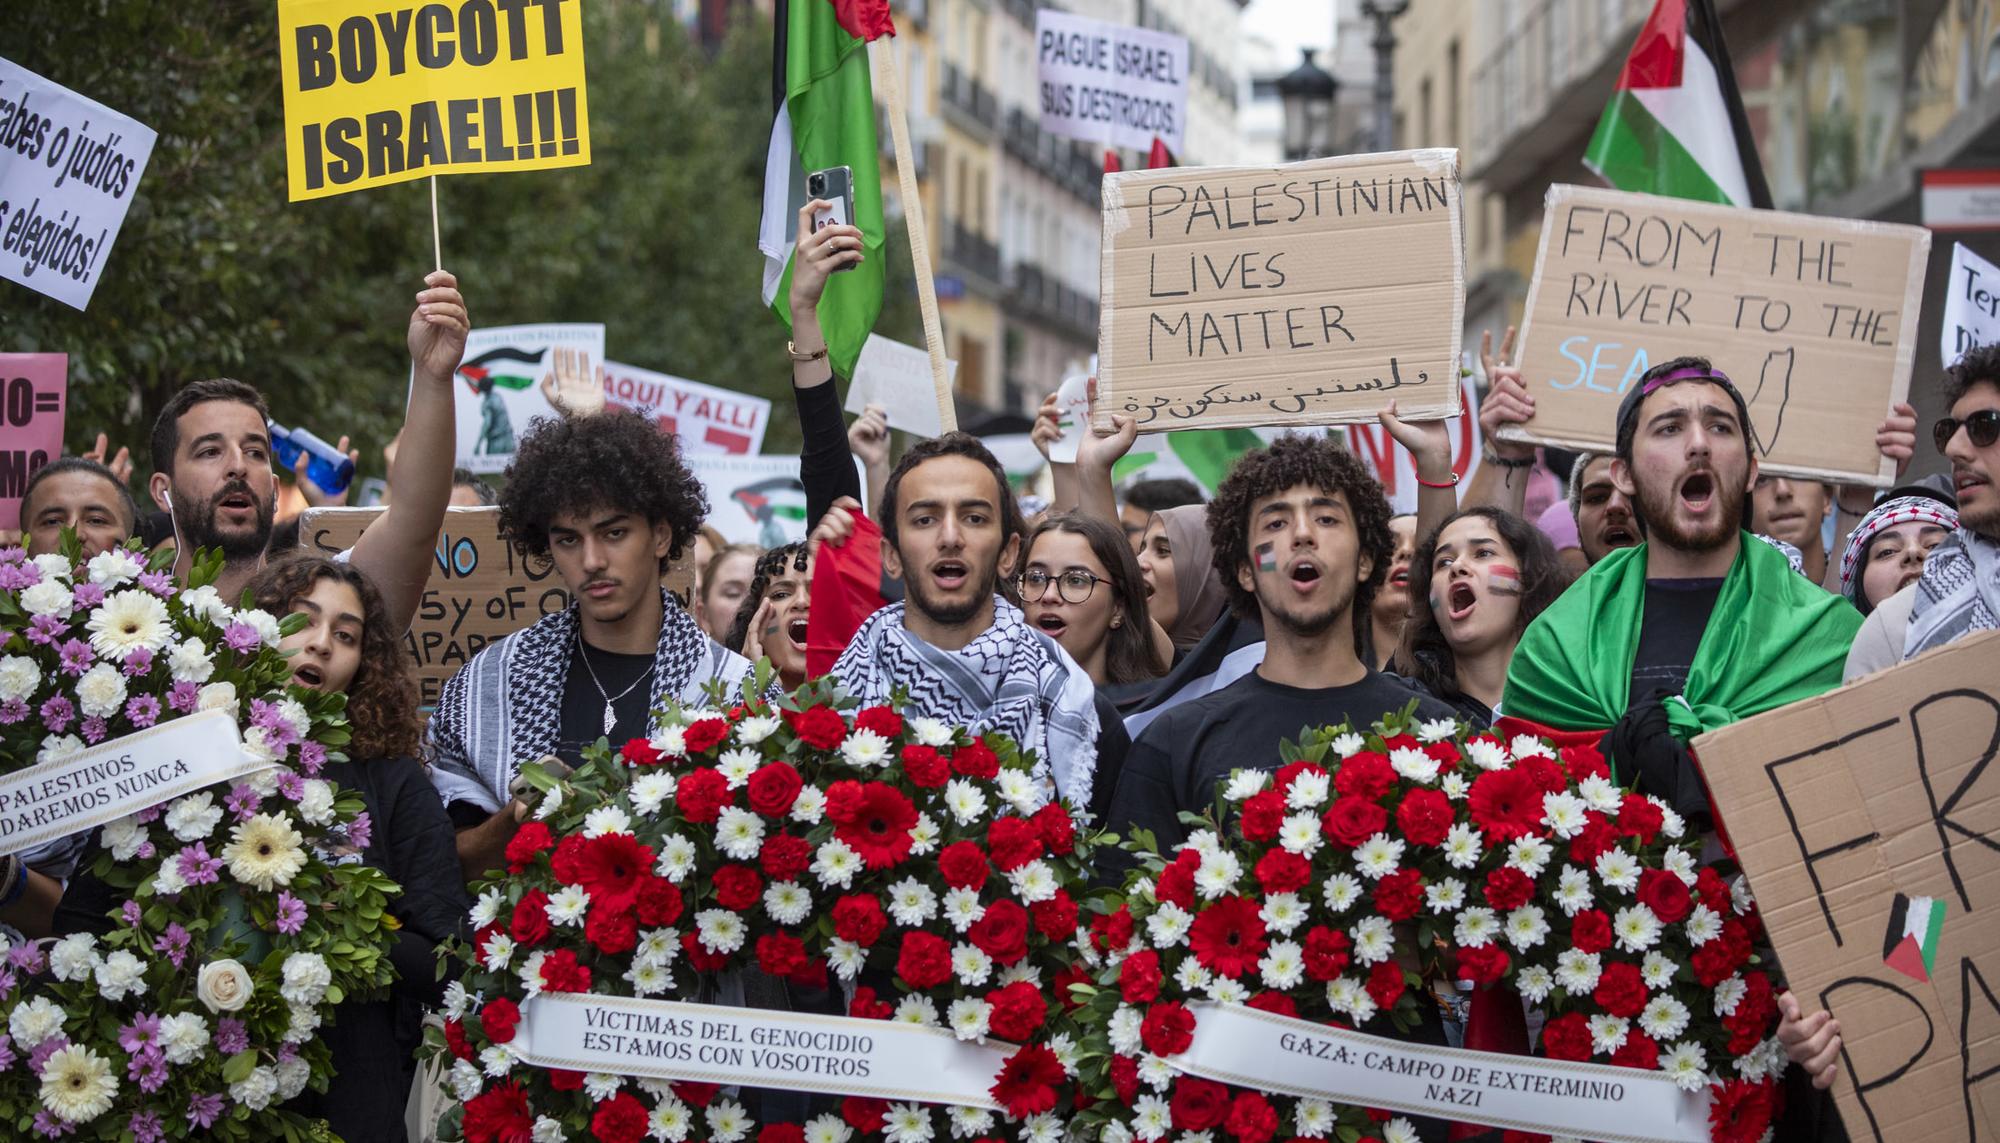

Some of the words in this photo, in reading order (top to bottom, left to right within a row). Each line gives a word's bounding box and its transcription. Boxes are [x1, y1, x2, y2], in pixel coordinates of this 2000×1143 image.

[295, 0, 570, 92] BOYCOTT
[1040, 29, 1108, 70] PAGUE
[1113, 41, 1180, 86] ISRAEL
[1040, 81, 1074, 118] SUS
[47, 126, 70, 168] o
[54, 120, 134, 199] judíos
[302, 87, 580, 190] ISRAEL!!!
[1148, 172, 1448, 240] PALESTINIAN
[3, 198, 107, 283] elegidos!
[1562, 206, 1722, 277] FROM
[1752, 232, 1853, 288] THE
[1150, 251, 1286, 298] LIVES
[1149, 304, 1356, 362] MATTER
[1565, 272, 1693, 327] RIVER
[1734, 294, 1792, 333] TO
[1822, 303, 1899, 347] THE
[1550, 335, 1649, 394] SEA
[604, 375, 665, 406] AQUÍ
[674, 391, 690, 412] Y
[694, 398, 758, 430] ALLÍ
[436, 532, 479, 579] NO
[0, 754, 136, 813] PALESTINOS
[115, 759, 191, 799] NUNCA
[583, 1032, 692, 1062] ESTAMOS
[698, 1045, 744, 1066] CON
[749, 1048, 871, 1078] VOSOTROS
[584, 1007, 693, 1038] VICTIMAS
[700, 1021, 744, 1043] DEL
[750, 1026, 873, 1054] GENOCIDIO
[1279, 1032, 1356, 1065] GAZA:
[1363, 1051, 1444, 1080] CAMPO
[1451, 1065, 1481, 1085] DE
[1487, 1071, 1625, 1102] EXTERMINIO
[1425, 1084, 1483, 1107] NAZI
